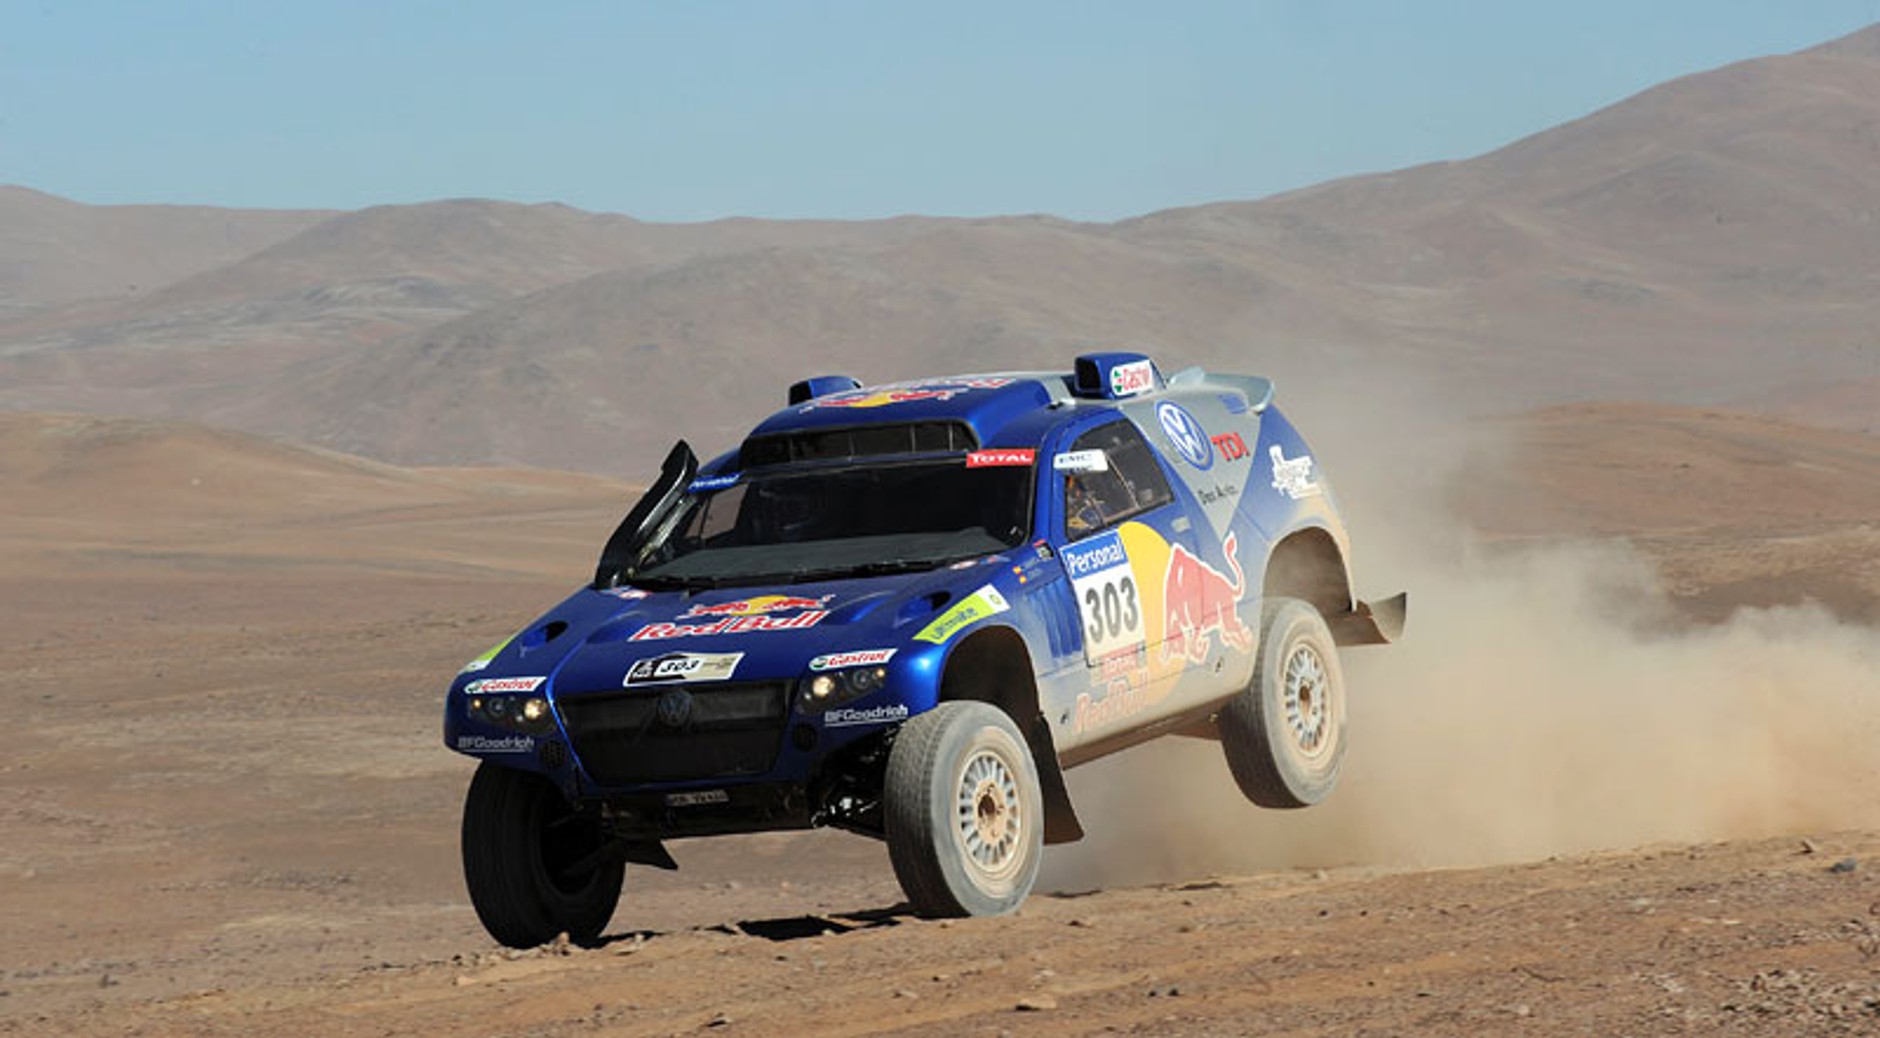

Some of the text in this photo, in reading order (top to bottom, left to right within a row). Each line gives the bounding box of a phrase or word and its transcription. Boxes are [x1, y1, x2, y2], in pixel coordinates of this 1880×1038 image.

[1210, 432, 1250, 462] TDI
[972, 453, 1033, 464] TOTAL
[1066, 536, 1124, 575] Personal
[1086, 576, 1138, 643] 303
[660, 660, 700, 673] 303
[828, 650, 890, 667] Castrol
[481, 679, 538, 692] Castrol
[825, 704, 908, 723] BFGoodrich
[458, 736, 535, 749] BFGoodrich
